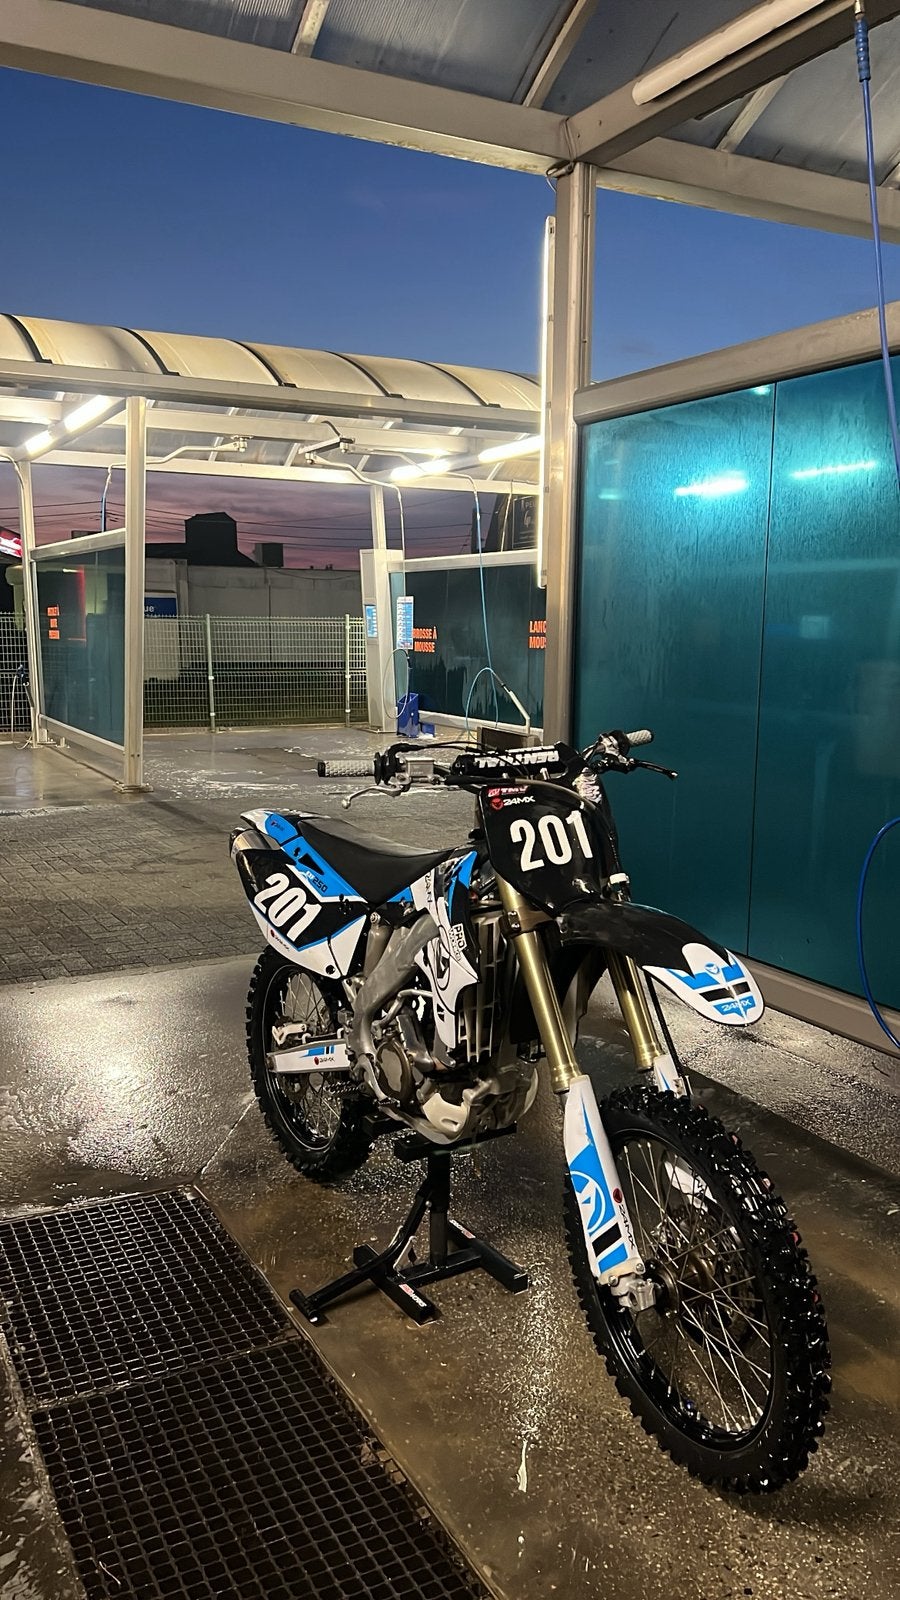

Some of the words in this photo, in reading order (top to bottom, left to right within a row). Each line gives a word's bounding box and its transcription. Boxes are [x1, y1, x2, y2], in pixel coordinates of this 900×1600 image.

[503, 795, 536, 807] 24MX
[509, 810, 593, 872] 201
[312, 876, 328, 893] 250
[254, 872, 323, 943] 201
[452, 924, 466, 949] PRO
[618, 1204, 636, 1250] 24MX
